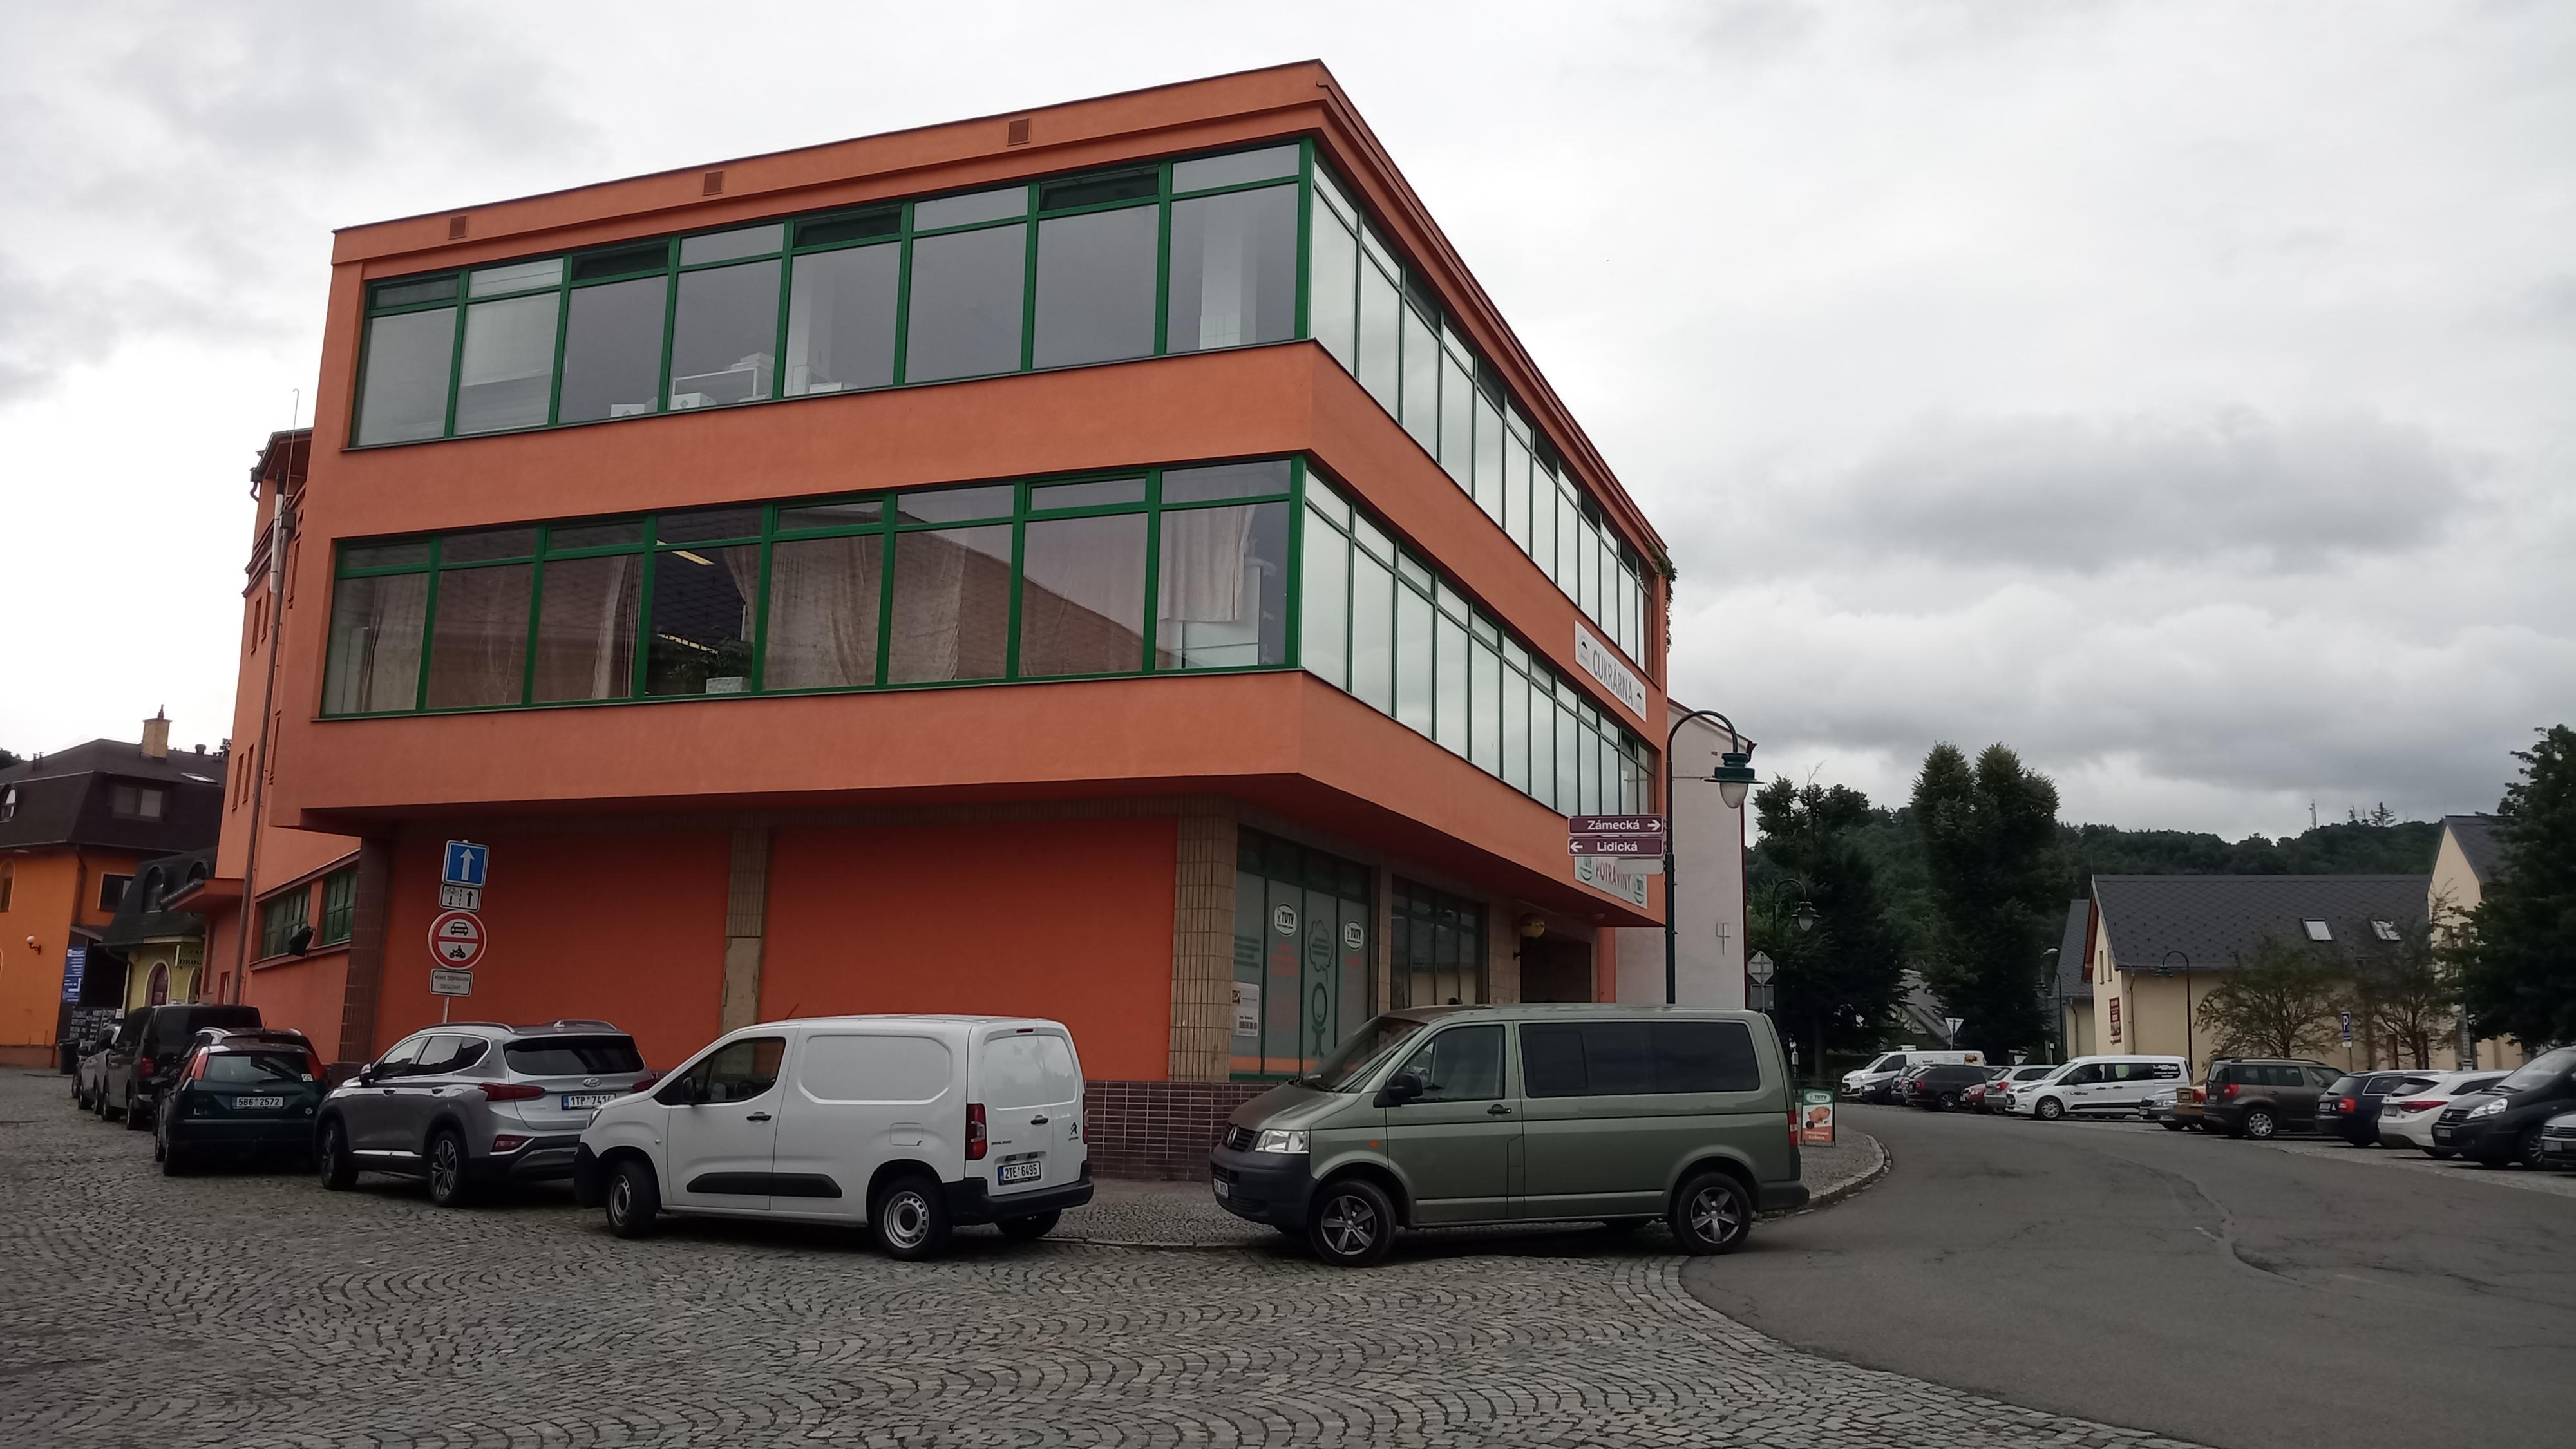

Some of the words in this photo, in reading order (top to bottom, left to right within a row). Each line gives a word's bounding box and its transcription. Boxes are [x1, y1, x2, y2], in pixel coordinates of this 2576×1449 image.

[1593, 649, 1633, 706] CUKRÁRNA
[1587, 819, 1640, 830] Zámecká
[1596, 841, 1638, 851] Lidická
[1282, 911, 1294, 925] TUTY
[2343, 1015, 2349, 1031] P
[571, 1096, 585, 1106] 1TP
[1005, 1167, 1018, 1179] 2TE
[1021, 1164, 1037, 1177] 6495
